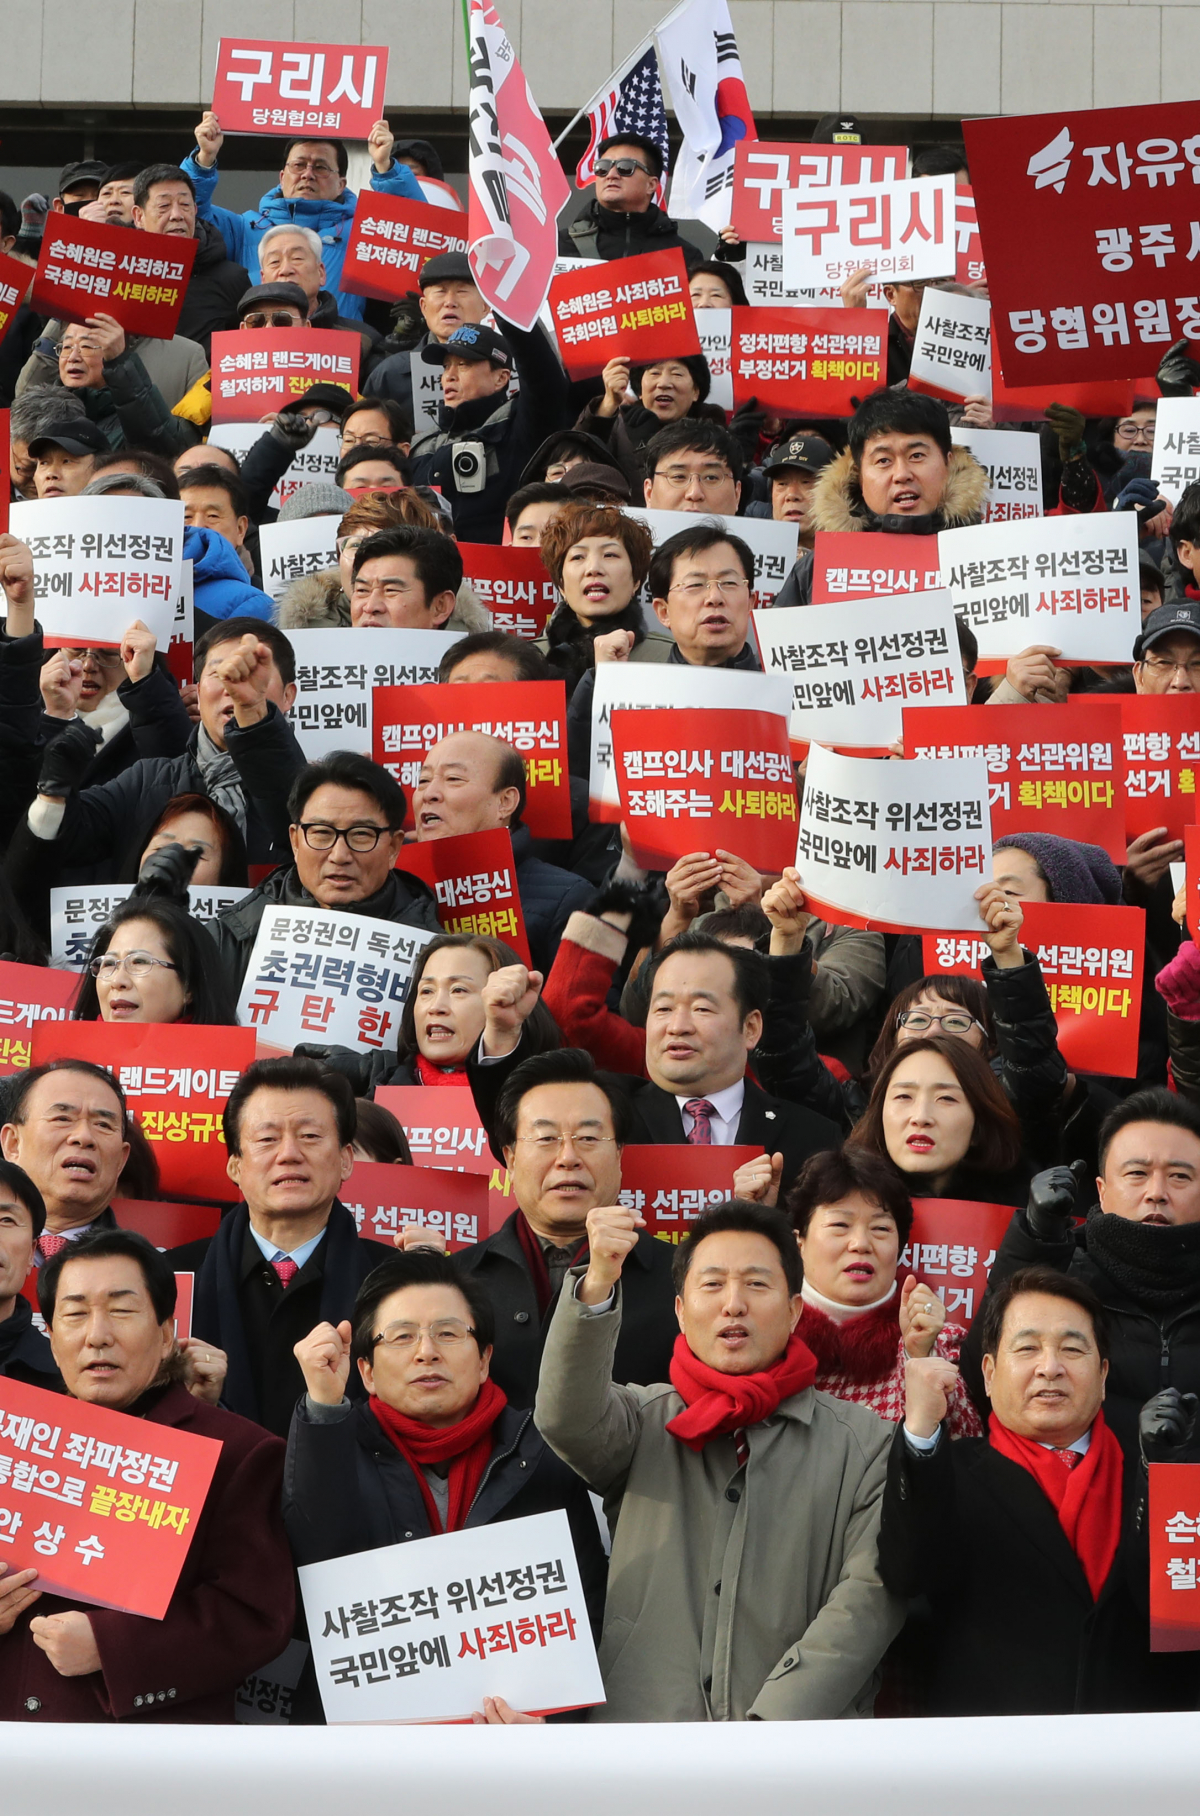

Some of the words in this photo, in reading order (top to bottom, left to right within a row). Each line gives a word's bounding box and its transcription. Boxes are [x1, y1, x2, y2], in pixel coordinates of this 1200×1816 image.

[226, 49, 378, 109] 구리시
[252, 108, 341, 129] 당원협의회
[360, 216, 410, 244] 손혜원
[795, 188, 944, 257] 구리시
[49, 239, 117, 271] 손혜원은
[118, 253, 185, 281] 사죄하고
[355, 241, 419, 270] 철저하게
[1095, 223, 1177, 273] 광주
[44, 264, 112, 298] 국회의원
[112, 280, 179, 307] 사퇴하라
[556, 289, 613, 321] 손혜원은
[615, 274, 683, 304] 사죄하고
[562, 315, 618, 347] 국회의원
[619, 301, 687, 333] 사퇴하라
[739, 333, 808, 356] 정치편향
[810, 334, 881, 356] 선관위원
[920, 340, 986, 373] 국민앞에
[219, 351, 268, 373] 손혜원
[272, 351, 353, 374] 랜드게이트
[738, 360, 807, 381] 부정선거
[810, 360, 880, 381] 획책이다
[219, 375, 285, 399] 철저하게
[80, 532, 174, 562] 위선정권
[78, 570, 172, 601] 사죄하라
[826, 567, 919, 593] 캠프인사
[949, 554, 1029, 591] 사찰조작
[1034, 548, 1129, 579] 위선정권
[952, 592, 1029, 630] 국민앞에
[1035, 586, 1130, 615] 사죄하라
[771, 640, 848, 673] 사찰조작
[854, 627, 949, 665] 위선정권
[294, 665, 367, 692] 찰조작
[791, 680, 854, 711] 민앞에
[860, 667, 954, 702] 사죄하라
[623, 749, 714, 779] 캠프인사
[720, 749, 792, 784] 대선공신
[1016, 742, 1113, 772] 선관위원
[628, 788, 713, 818] 조해주는
[718, 788, 796, 822] 사퇴하라
[804, 785, 879, 831] 사찰조작
[885, 800, 983, 832] 위선정권
[1018, 780, 1115, 809] 획책이다
[799, 828, 877, 875] 국민앞에
[883, 844, 985, 876] 사죄하라
[434, 869, 513, 908] 대선공신
[270, 917, 361, 952] 문정권의
[1037, 945, 1134, 978] 선관위원
[119, 1065, 241, 1099] 랜드게이트
[403, 1126, 487, 1157] 프인사
[62, 1432, 180, 1493] 좌파정권
[89, 1483, 191, 1536] 끝장내자
[322, 1586, 439, 1640] 사찰조작
[446, 1558, 569, 1615] 위선정권
[329, 1634, 451, 1689] 국민앞에
[457, 1607, 578, 1661] 사죄하라
